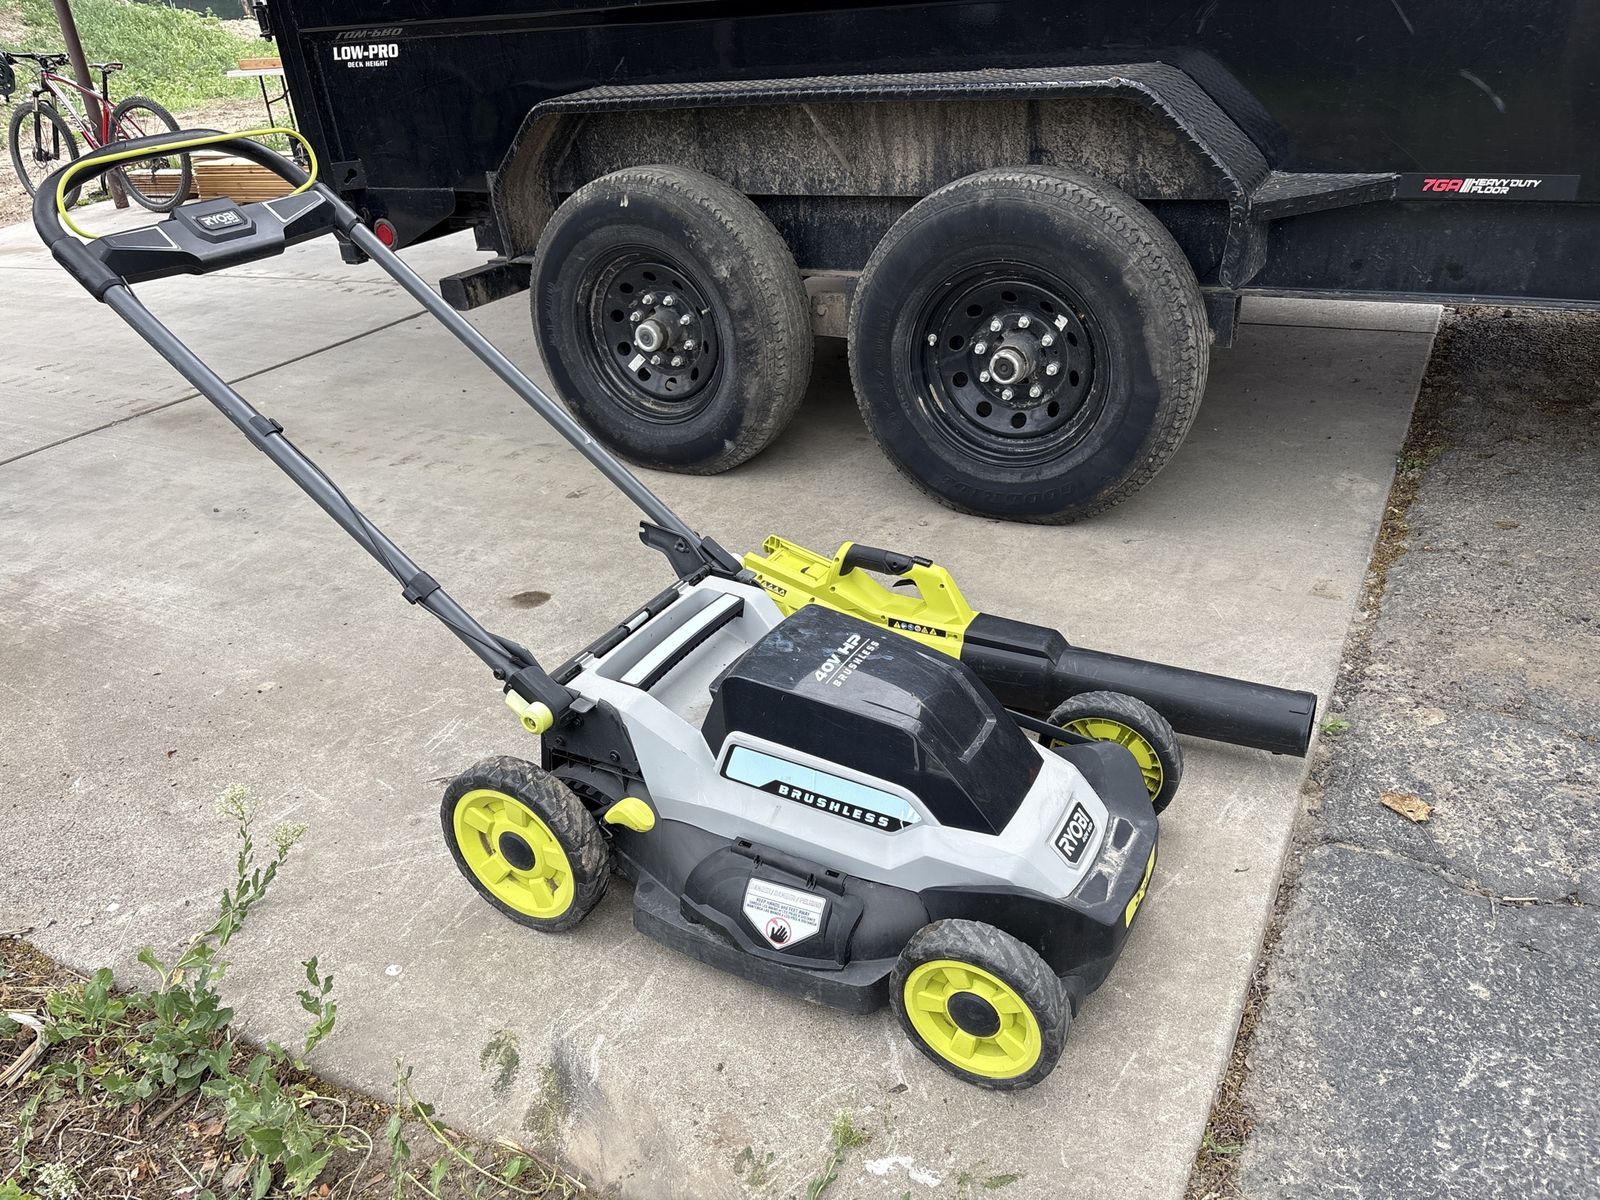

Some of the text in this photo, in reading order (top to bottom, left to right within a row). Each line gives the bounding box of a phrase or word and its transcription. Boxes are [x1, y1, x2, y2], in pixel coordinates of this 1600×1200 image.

[333, 44, 399, 60] LOW-PRO
[1422, 179, 1463, 192] 7GA
[1470, 186, 1510, 195] FLOOR
[1471, 178, 1542, 188] HEAVY DUTY
[201, 211, 238, 226] RYOBI
[814, 634, 861, 682] 40V HP
[832, 640, 880, 687] BRUSHLESS
[778, 784, 889, 828] BRUSHLESS
[1058, 807, 1090, 857] RYOBI
